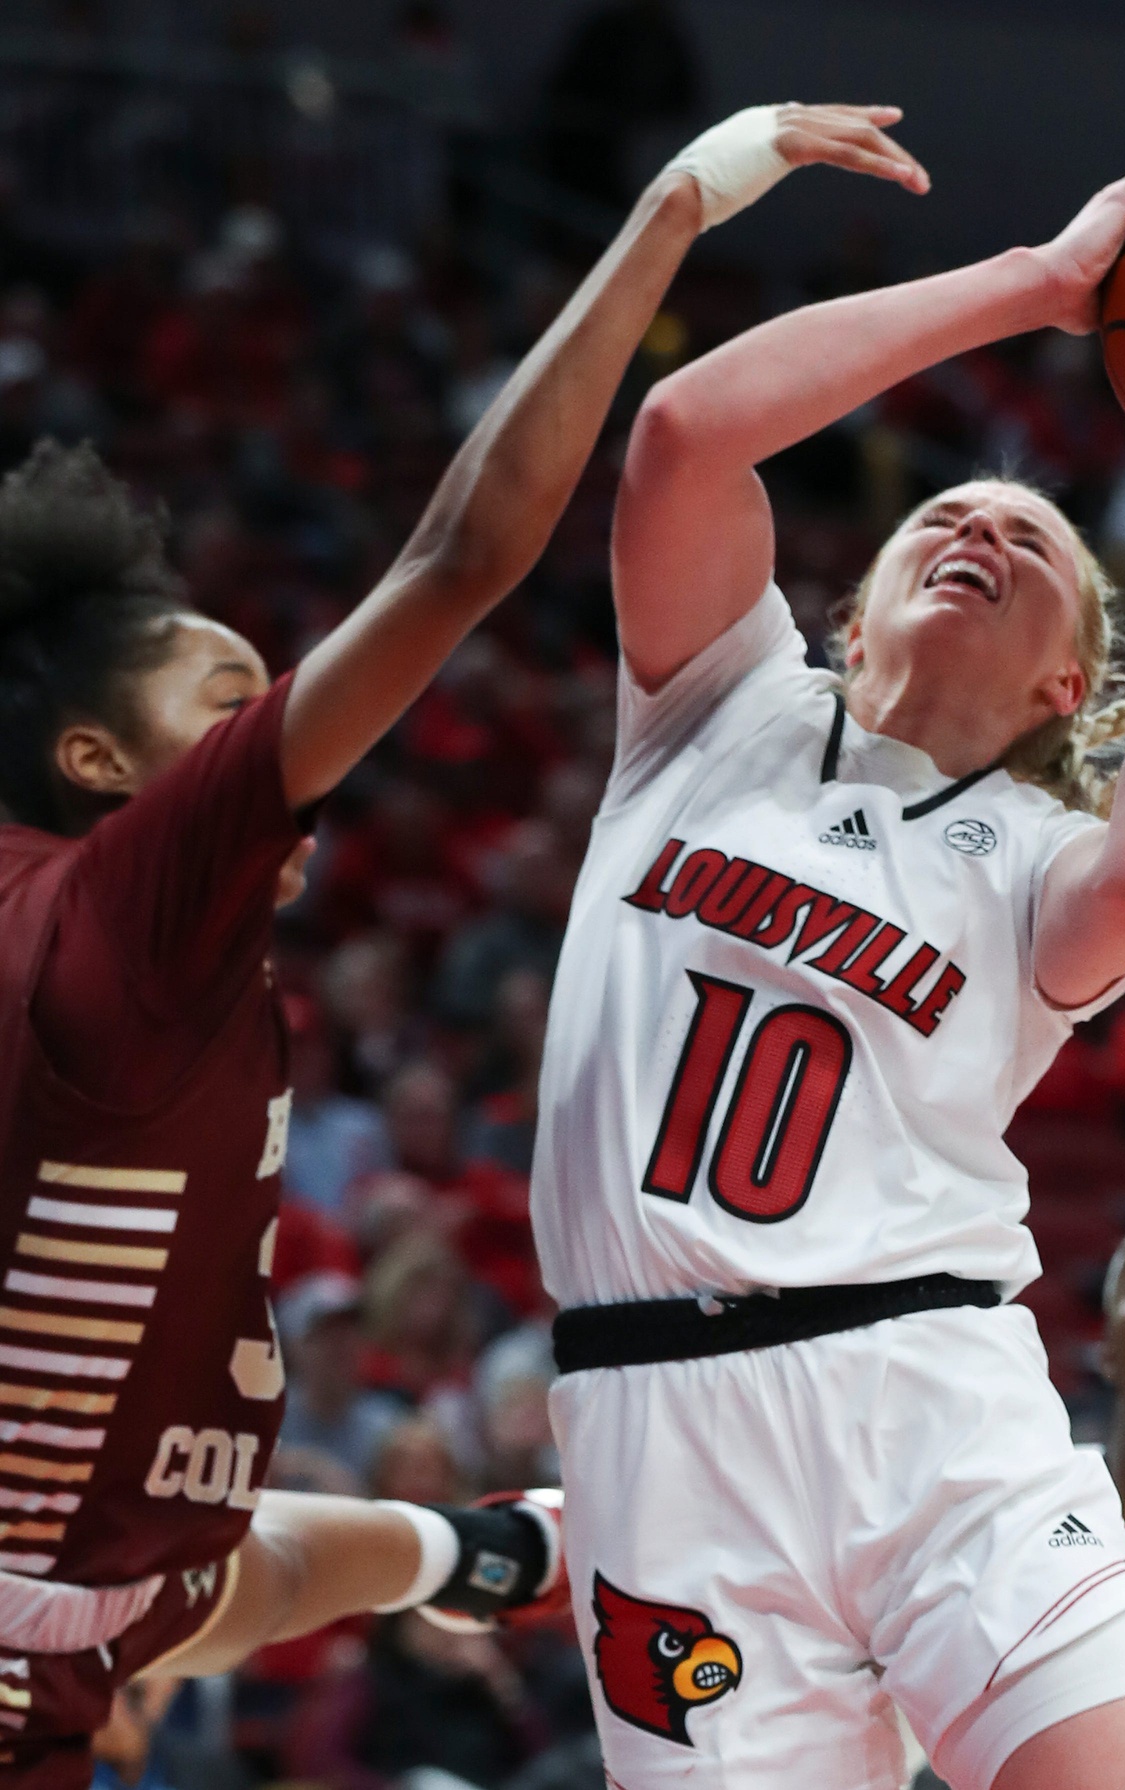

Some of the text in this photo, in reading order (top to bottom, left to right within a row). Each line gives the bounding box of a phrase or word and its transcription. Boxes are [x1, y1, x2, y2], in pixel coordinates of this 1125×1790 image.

[621, 838, 967, 1038] LOUISVILLE
[819, 832, 877, 851] adidas
[641, 969, 853, 1224] 10
